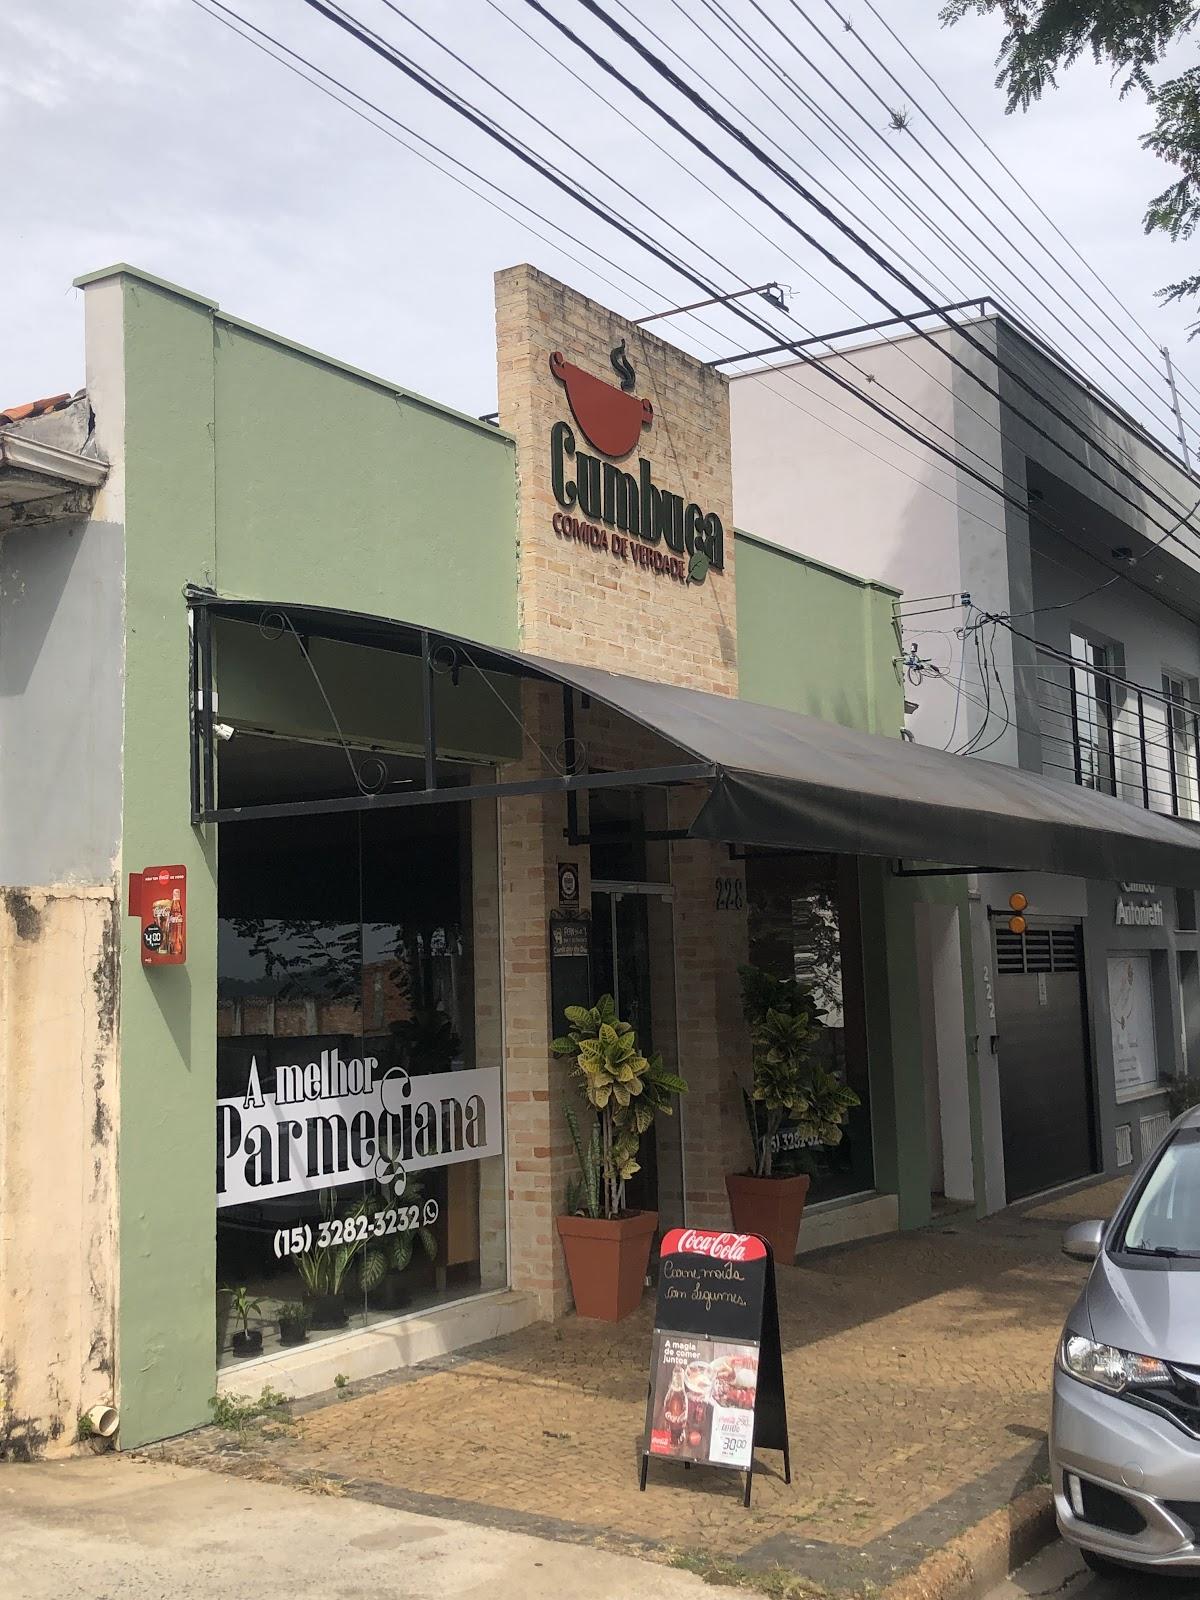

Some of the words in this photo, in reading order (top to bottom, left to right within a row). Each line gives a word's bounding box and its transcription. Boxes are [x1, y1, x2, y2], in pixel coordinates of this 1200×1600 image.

[551, 421, 725, 570] Cumbuca
[552, 512, 608, 552] COMIDA
[611, 533, 629, 559] DE
[630, 542, 686, 581] VERDADE
[243, 1055, 265, 1109] A
[275, 1048, 379, 1105] melhor
[216, 1066, 488, 1197] Parmegiana
[273, 1223, 312, 1259] (15)
[317, 1204, 420, 1248] 3282-3232
[677, 1229, 751, 1260] Coca-Cola
[663, 1357, 688, 1365] juntos
[664, 1340, 670, 1348] A
[675, 1350, 701, 1358] comer
